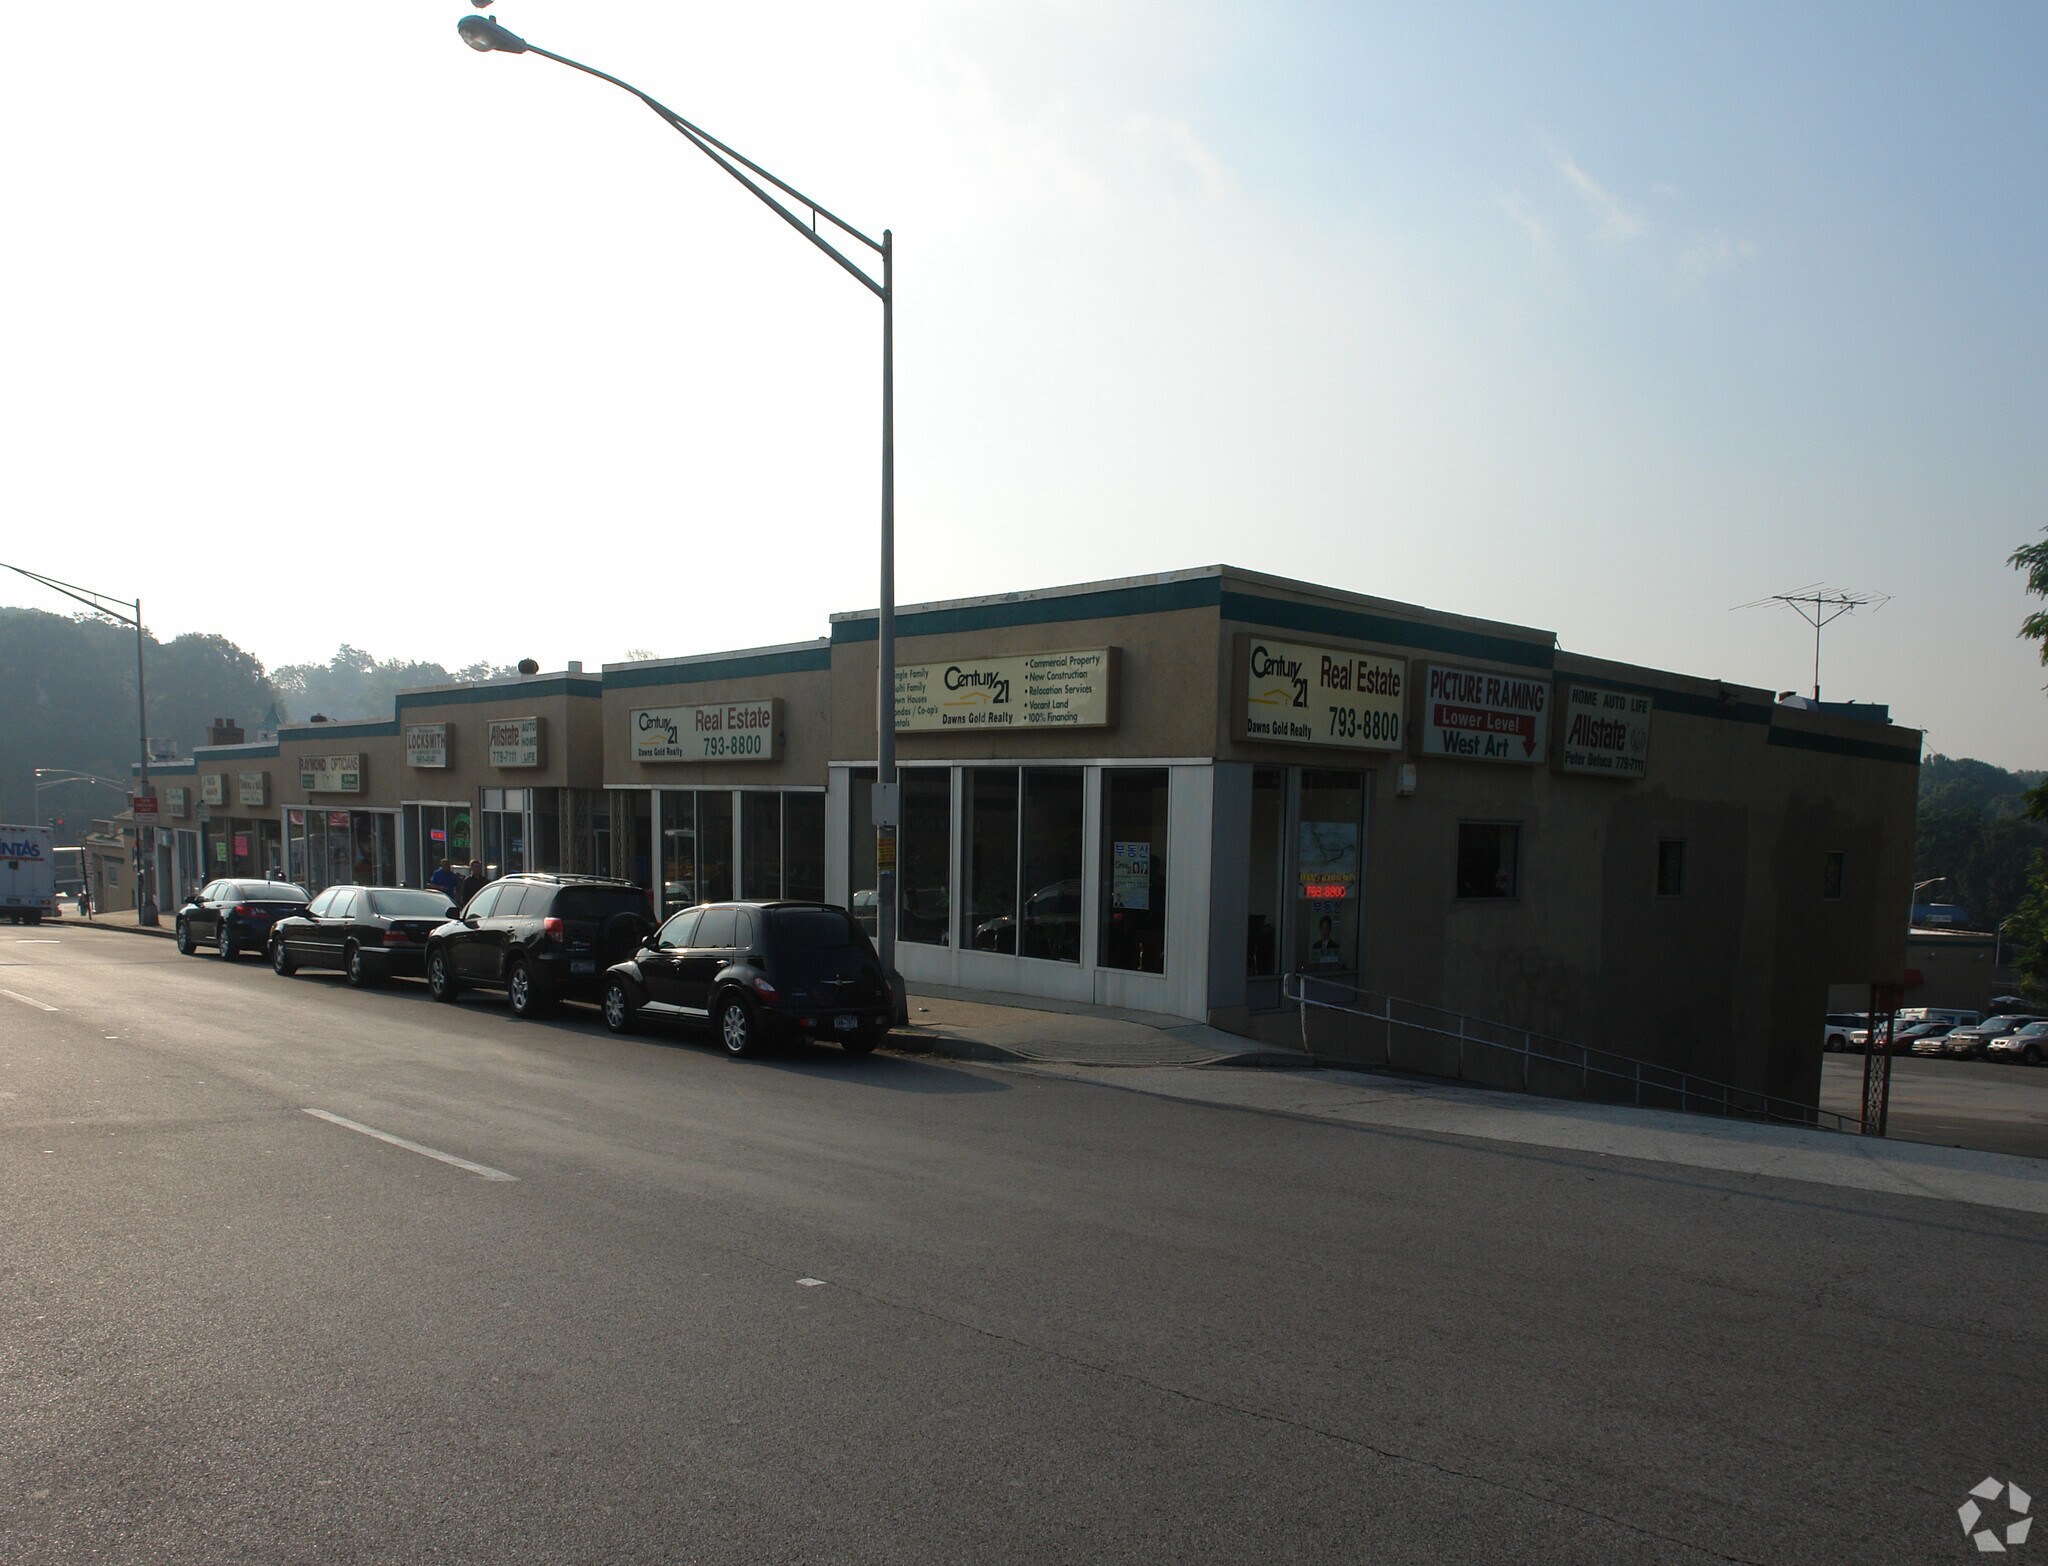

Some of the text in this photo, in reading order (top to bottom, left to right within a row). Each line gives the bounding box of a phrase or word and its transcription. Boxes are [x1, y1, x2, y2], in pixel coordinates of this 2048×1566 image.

[1029, 655, 1100, 668] Commercial Property
[910, 668, 929, 680] Family
[1029, 670, 1088, 682] New Construction
[1251, 646, 1308, 708] Century 21
[1320, 655, 1401, 697] Real Estate
[906, 683, 926, 695] Family
[944, 666, 1010, 704] Century 21
[1029, 684, 1092, 696] Relocation Services
[1430, 669, 1544, 712] PICTURE FRAMING
[907, 695, 927, 704] Houses
[1029, 699, 1069, 710] Vacant Land
[1572, 689, 1648, 713] HOME AUTO LIFE
[695, 707, 771, 731] Real Estate
[942, 712, 1013, 725] Dawns Gold Realty
[1028, 712, 1078, 723] 100% Financing
[1329, 706, 1398, 741] 793-8800
[1442, 706, 1520, 732] Lower Level
[490, 725, 519, 746] Allstate
[522, 723, 536, 732] AUTO
[639, 713, 678, 744] Century 21
[1247, 719, 1312, 740] Dawns Gold Realty
[1568, 714, 1626, 751] Allstate
[408, 733, 445, 749] LOCKSMITH
[521, 737, 537, 746] HOME
[703, 735, 761, 756] 793-8800
[1442, 730, 1509, 757] West Art
[331, 757, 358, 771] OPTICIANS
[492, 751, 517, 762] 779-7111
[523, 752, 535, 762] LIFE
[1565, 751, 1586, 766] Peter
[1615, 756, 1645, 772] 779-7111
[1115, 844, 1149, 859] 부동산
